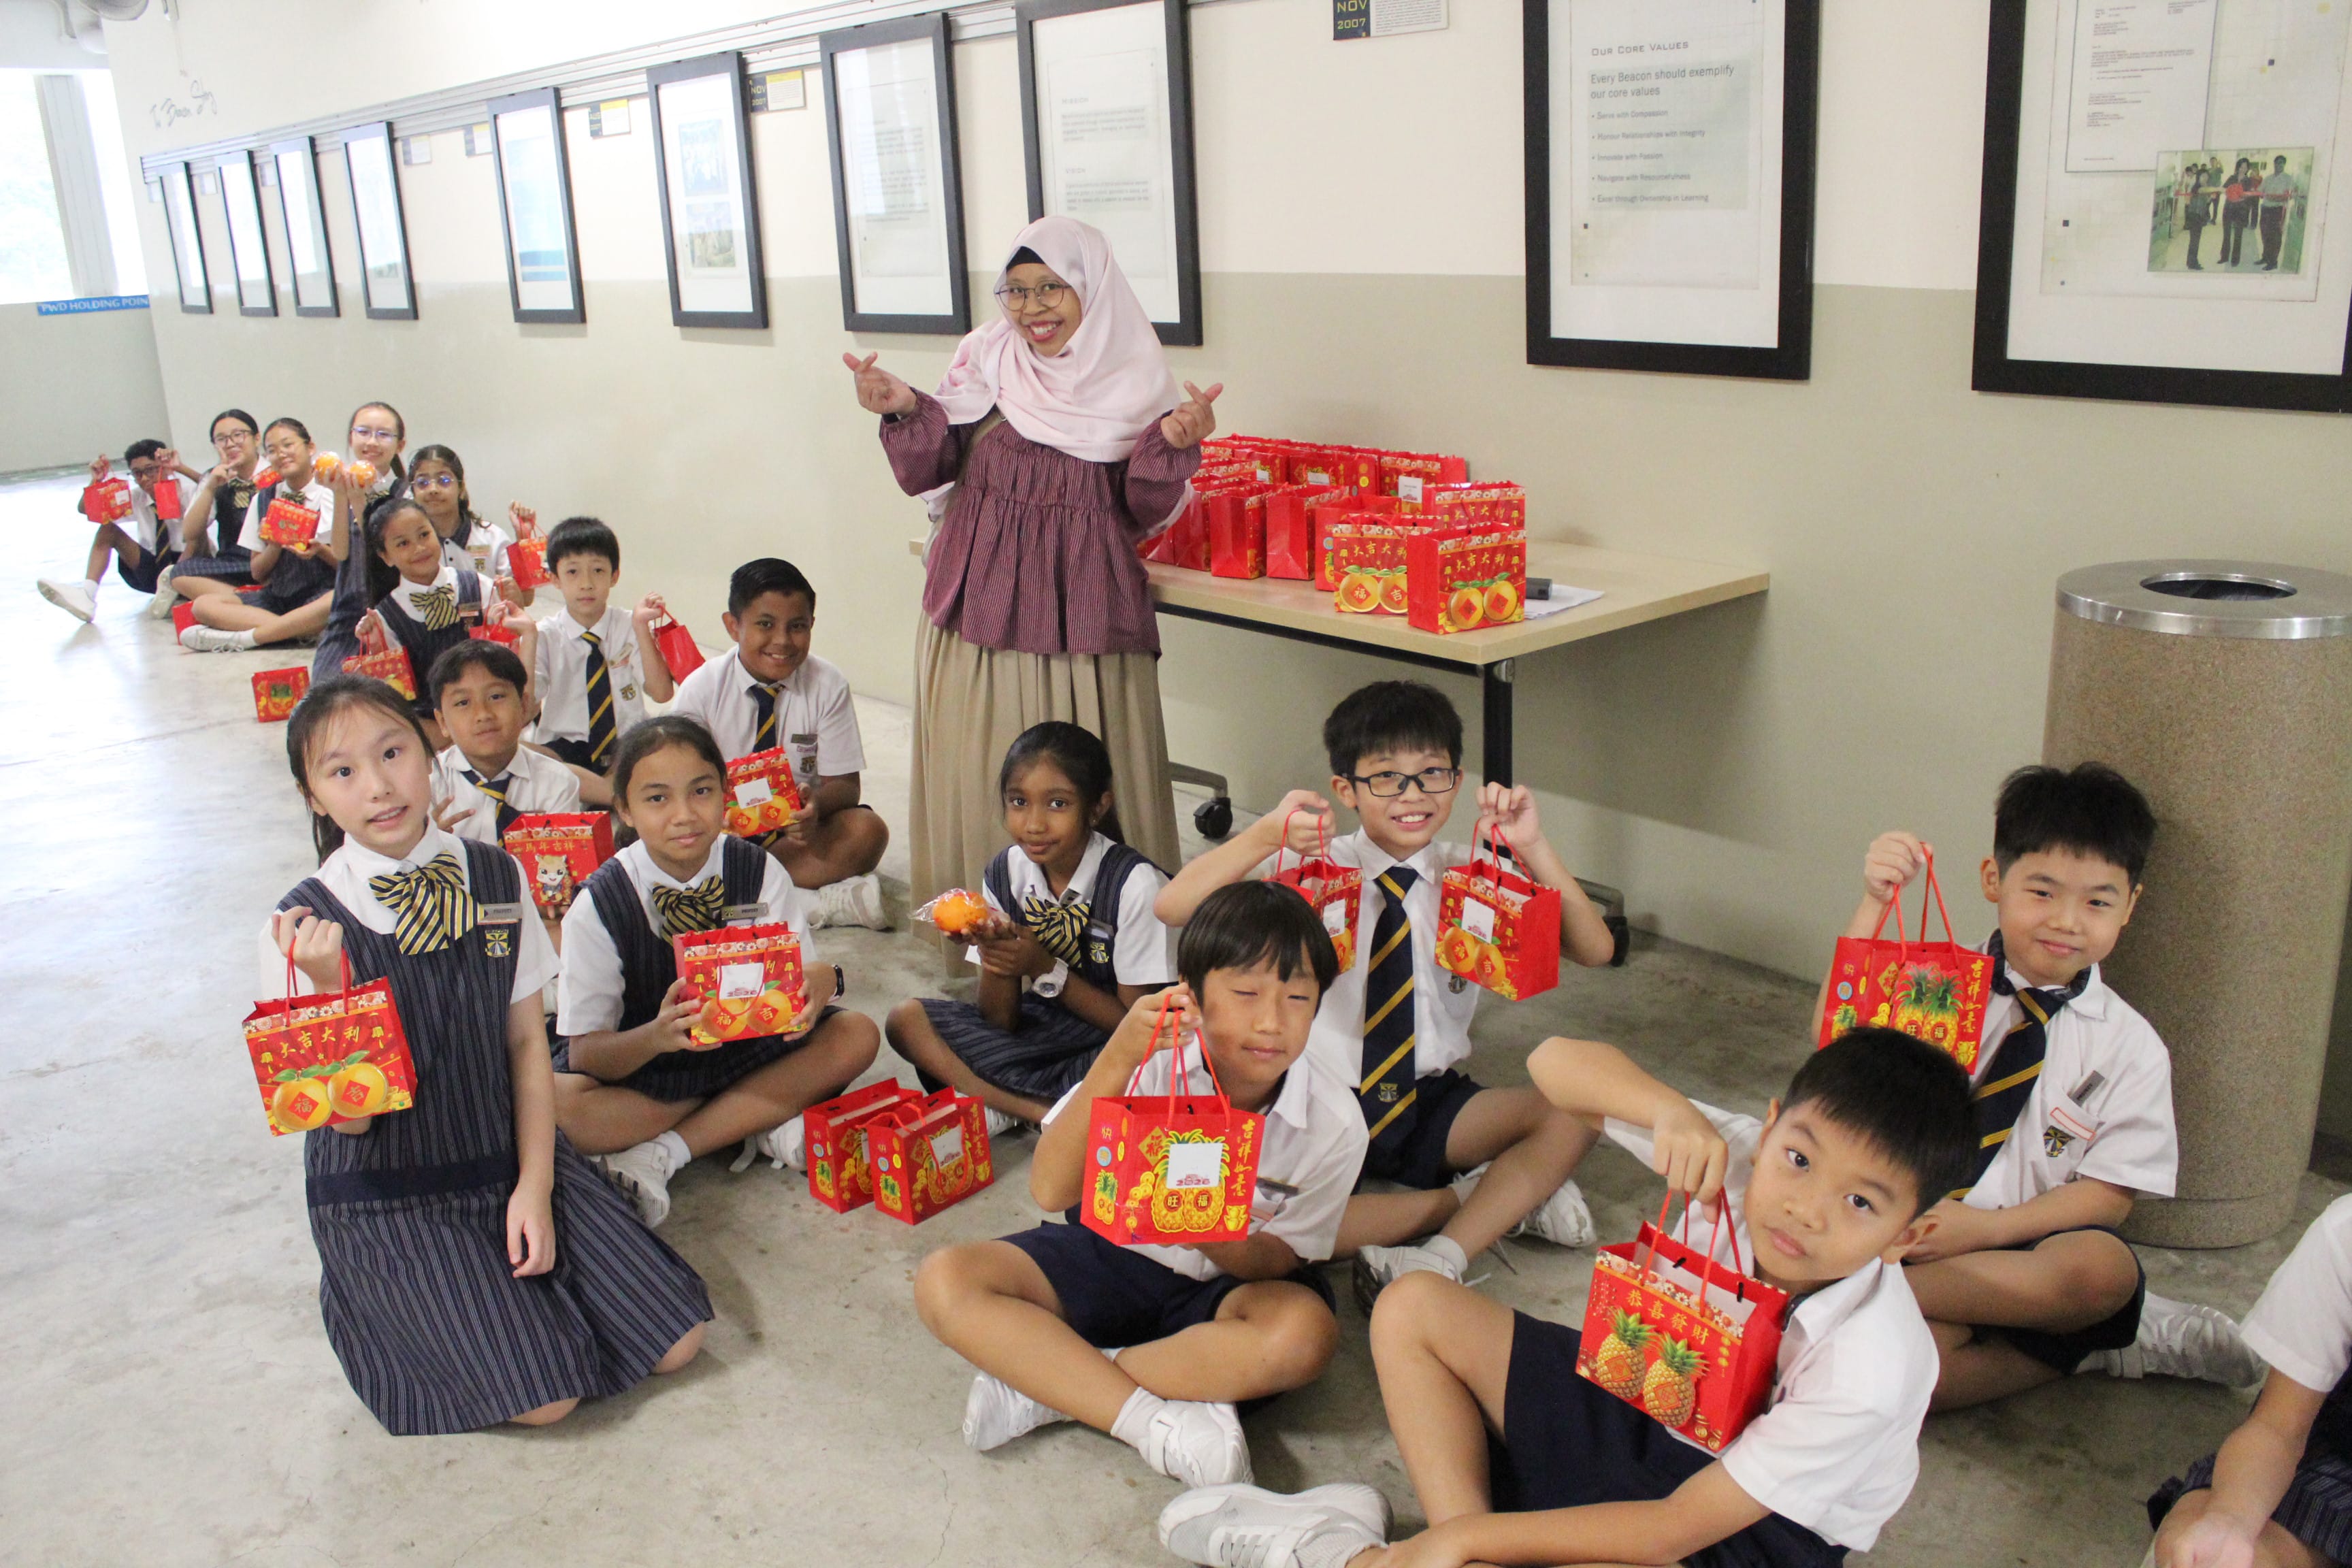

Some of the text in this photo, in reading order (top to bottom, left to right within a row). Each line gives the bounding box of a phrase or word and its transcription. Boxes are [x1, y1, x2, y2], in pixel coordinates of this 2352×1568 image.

[1337, 0, 1367, 12] NOV
[1337, 18, 1366, 29] 2007
[1592, 42, 1689, 56] OUR CORE VALUES
[1591, 65, 1735, 85] Every Beacon should exemplify
[751, 86, 766, 95] NOV
[1591, 86, 1660, 99] our core values
[1631, 110, 1668, 118] Compassion
[1680, 129, 1705, 138] Integrity
[1640, 173, 1691, 181] Resourcefulness
[1681, 194, 1710, 203] Learning
[41, 297, 148, 312] PWD HOLDING POIN
[1354, 587, 1367, 600] 福
[1390, 589, 1403, 601] 吉
[760, 1007, 774, 1021] 吉
[280, 1026, 360, 1058] 大吉大利
[346, 1085, 364, 1102] 吉
[295, 1094, 312, 1113] 福
[1230, 1118, 1256, 1196] 吉祥如意
[1167, 1195, 1179, 1207] 旺
[1198, 1193, 1209, 1207] 福
[1626, 1288, 1710, 1345] 恭喜發財
